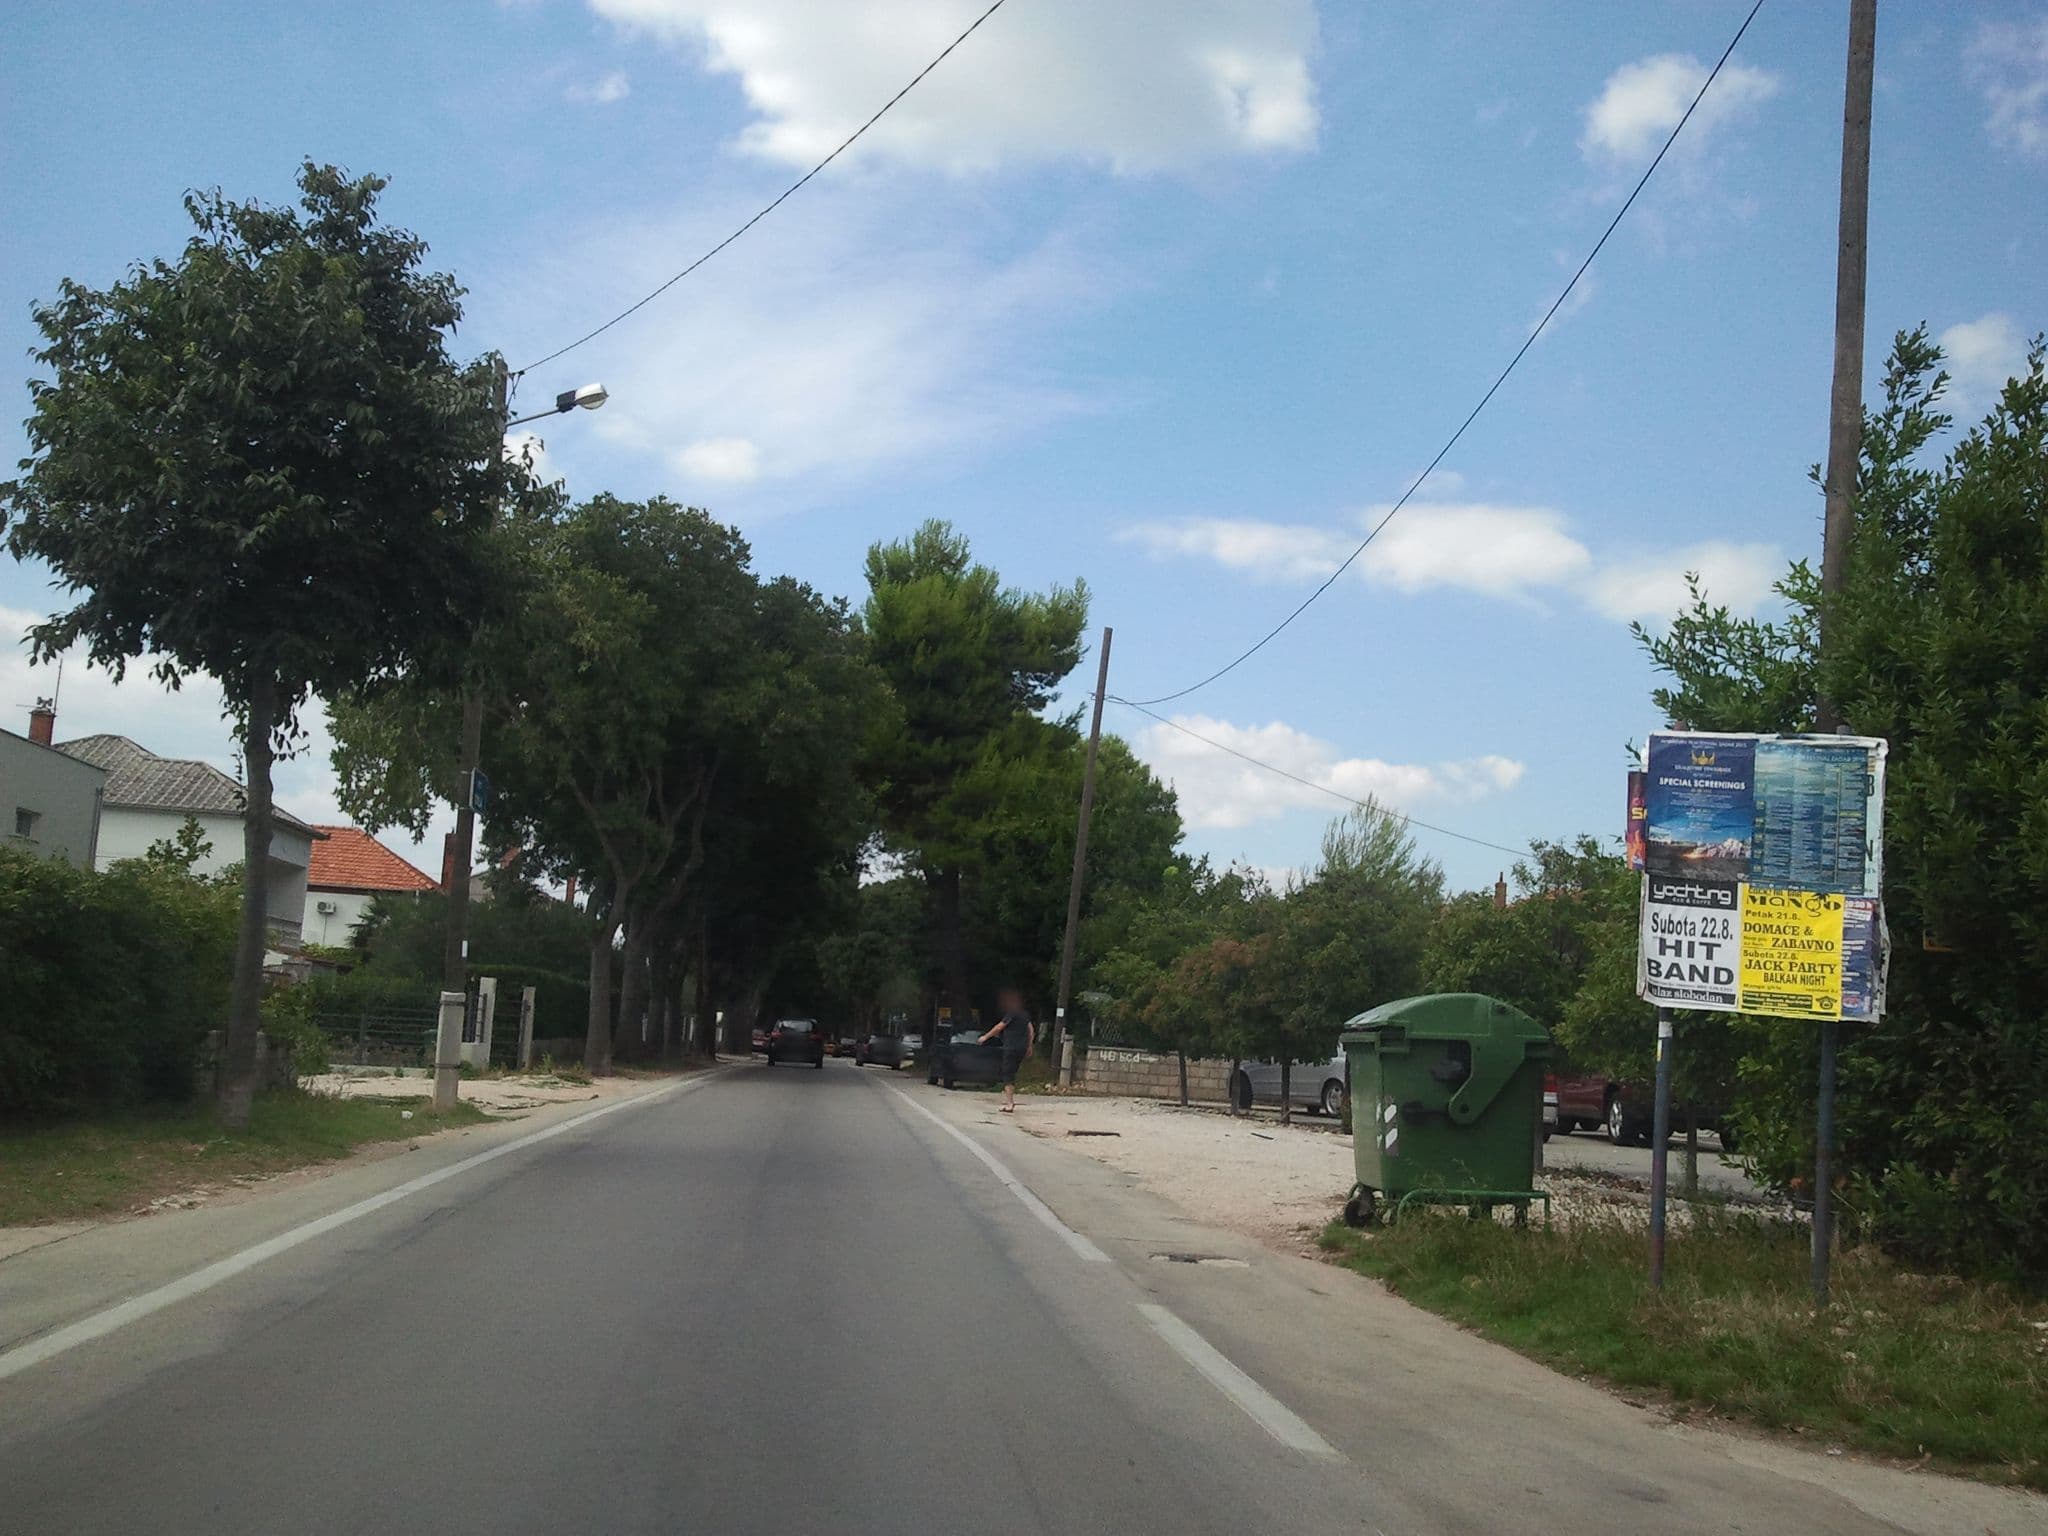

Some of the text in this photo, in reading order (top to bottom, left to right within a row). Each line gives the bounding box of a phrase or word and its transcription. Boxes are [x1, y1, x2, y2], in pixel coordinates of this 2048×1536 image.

[1659, 777, 1746, 790] SPECIAL SCREENINGS
[1745, 910, 1773, 919] Petak
[1651, 912, 1733, 940] Subota 22.8.
[1803, 927, 1814, 936] &
[1658, 937, 1721, 961] HIT
[1771, 937, 1834, 951] ZABAVNO
[1743, 950, 1774, 959] Subota
[1647, 958, 1734, 985] BAND
[1744, 959, 1837, 975] JACK PARTY
[1763, 972, 1826, 986] BALKAN NIGHT
[1651, 986, 1723, 1003] ulaz slobodan
